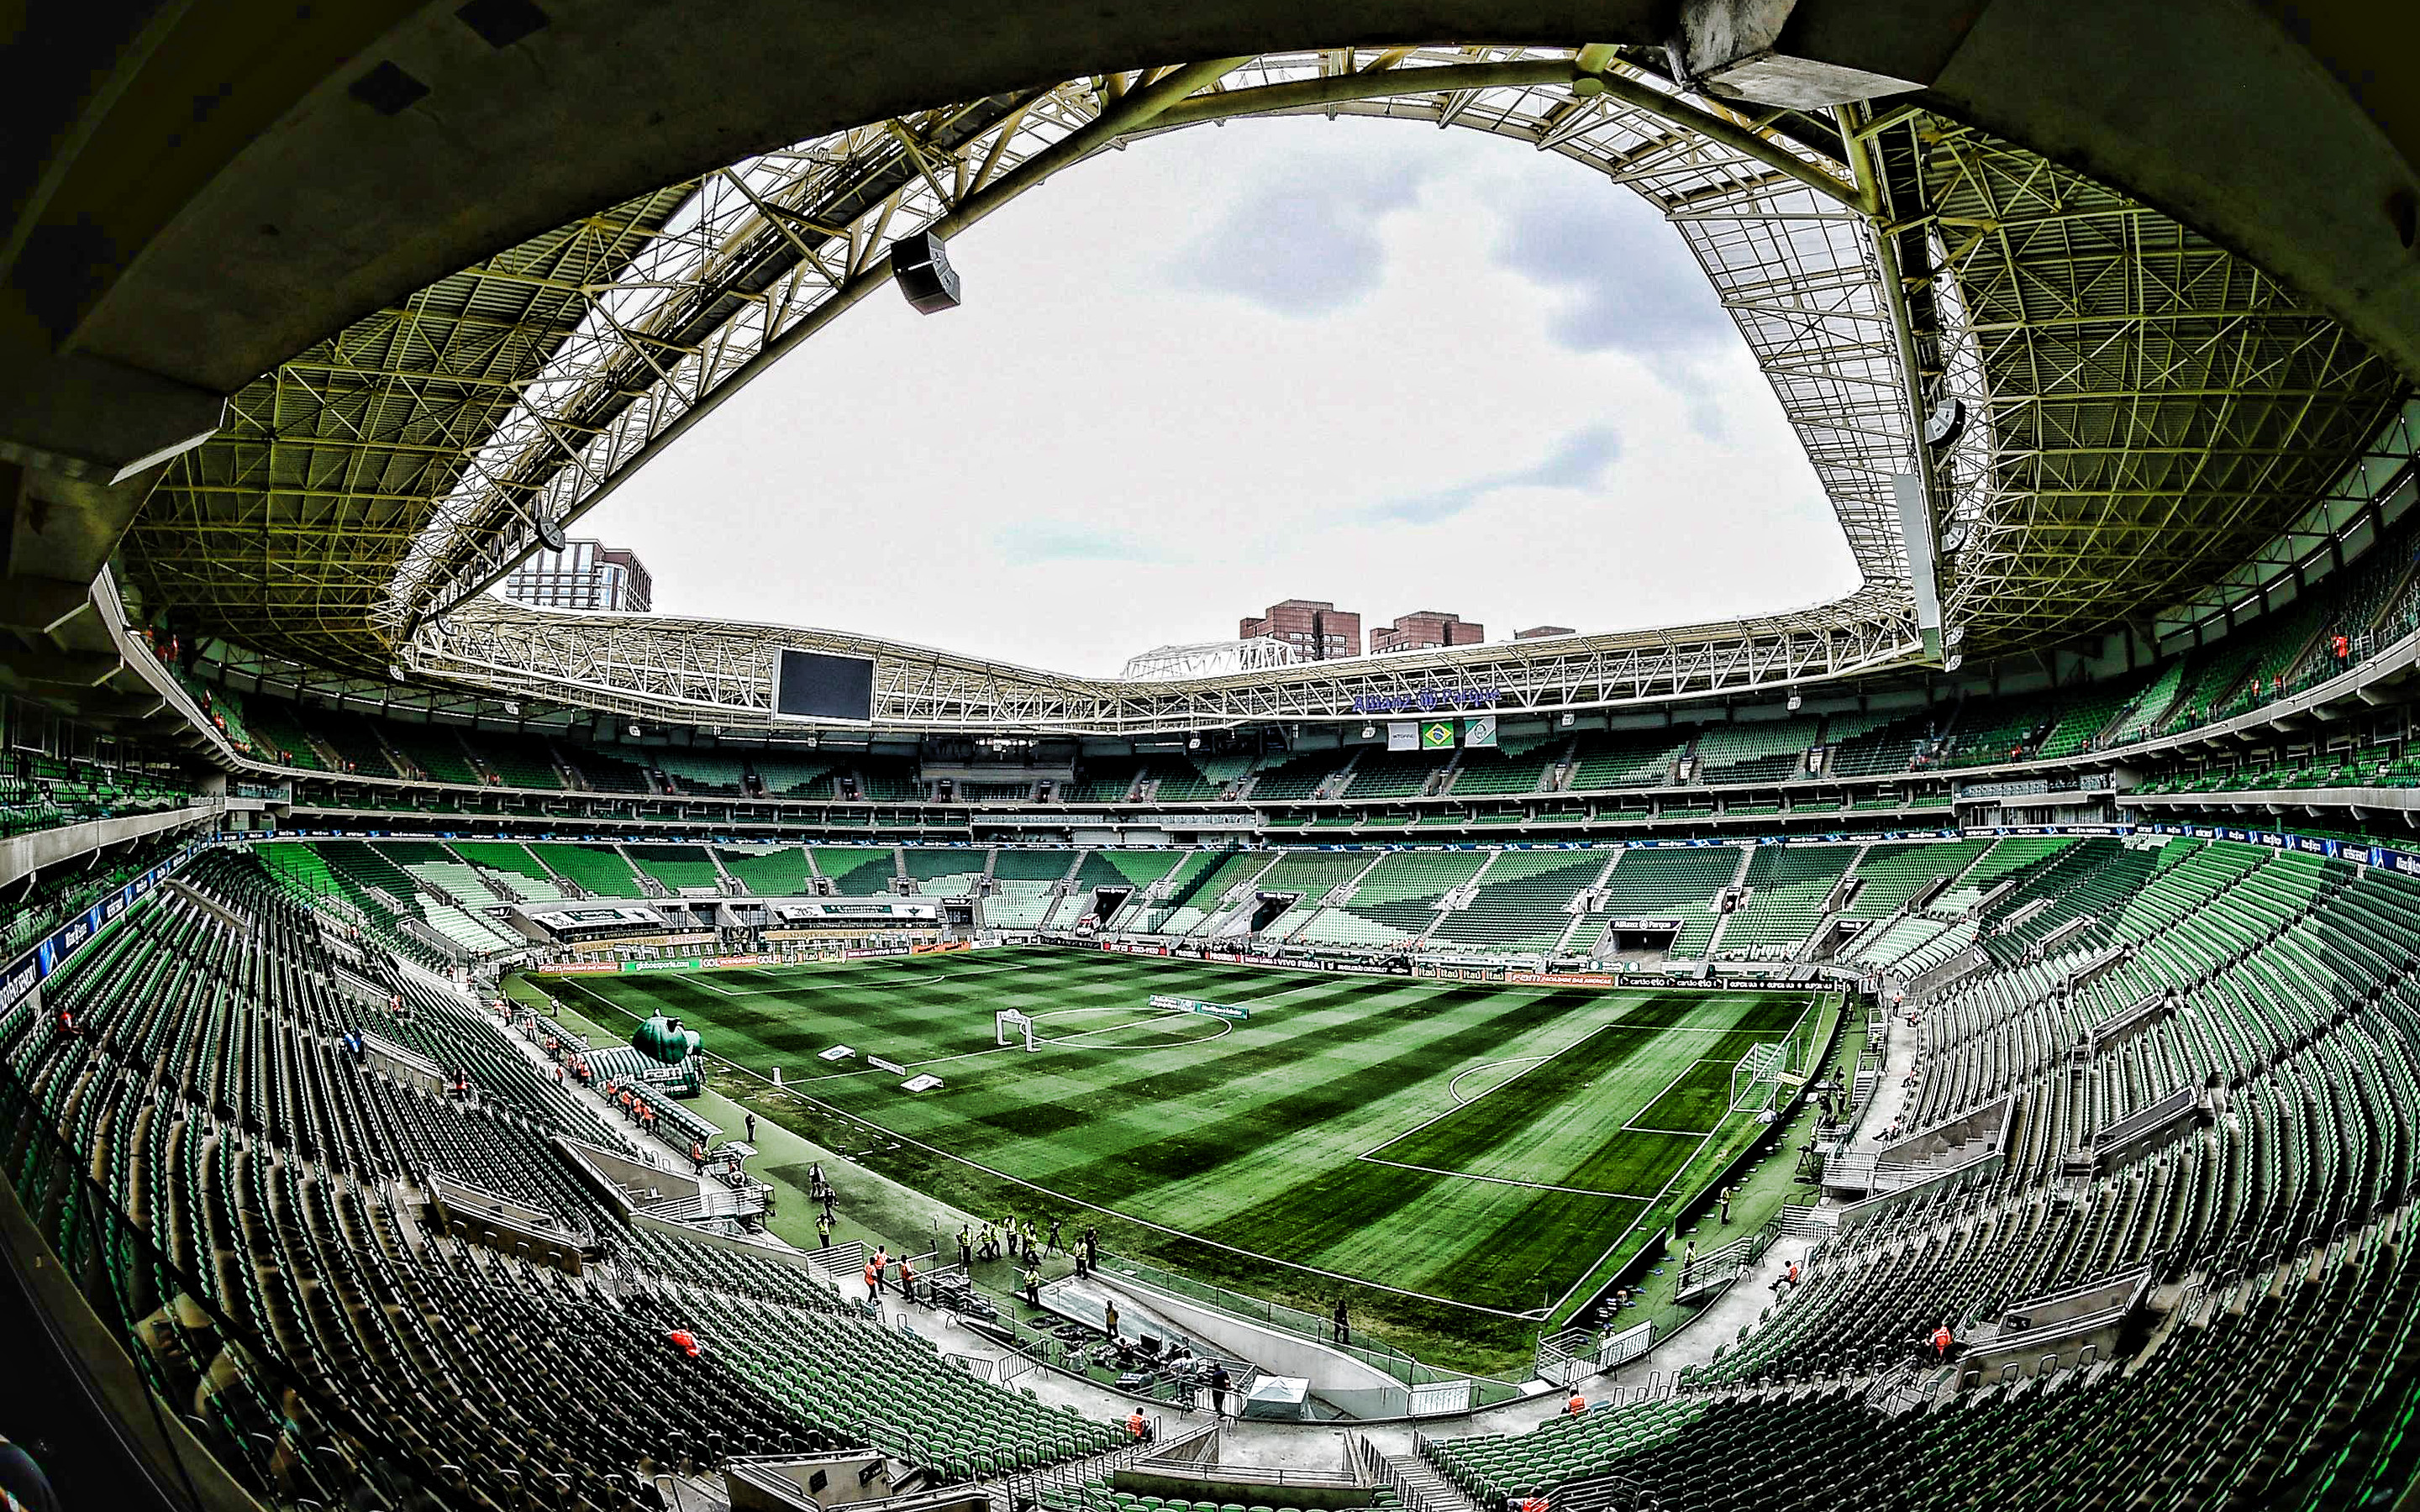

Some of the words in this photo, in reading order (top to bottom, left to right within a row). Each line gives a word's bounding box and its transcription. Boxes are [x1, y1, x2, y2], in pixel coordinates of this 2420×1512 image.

[1352, 693, 1411, 712] Allianz
[1442, 688, 1502, 707] Parque
[1648, 921, 1670, 930] Parque
[1418, 967, 1436, 977] Itaú
[1440, 968, 1459, 978] Itaú
[1463, 969, 1481, 979] Itaú
[1486, 969, 1504, 980] Itaú
[1650, 978, 1665, 986] elo
[1697, 979, 1712, 987] elo
